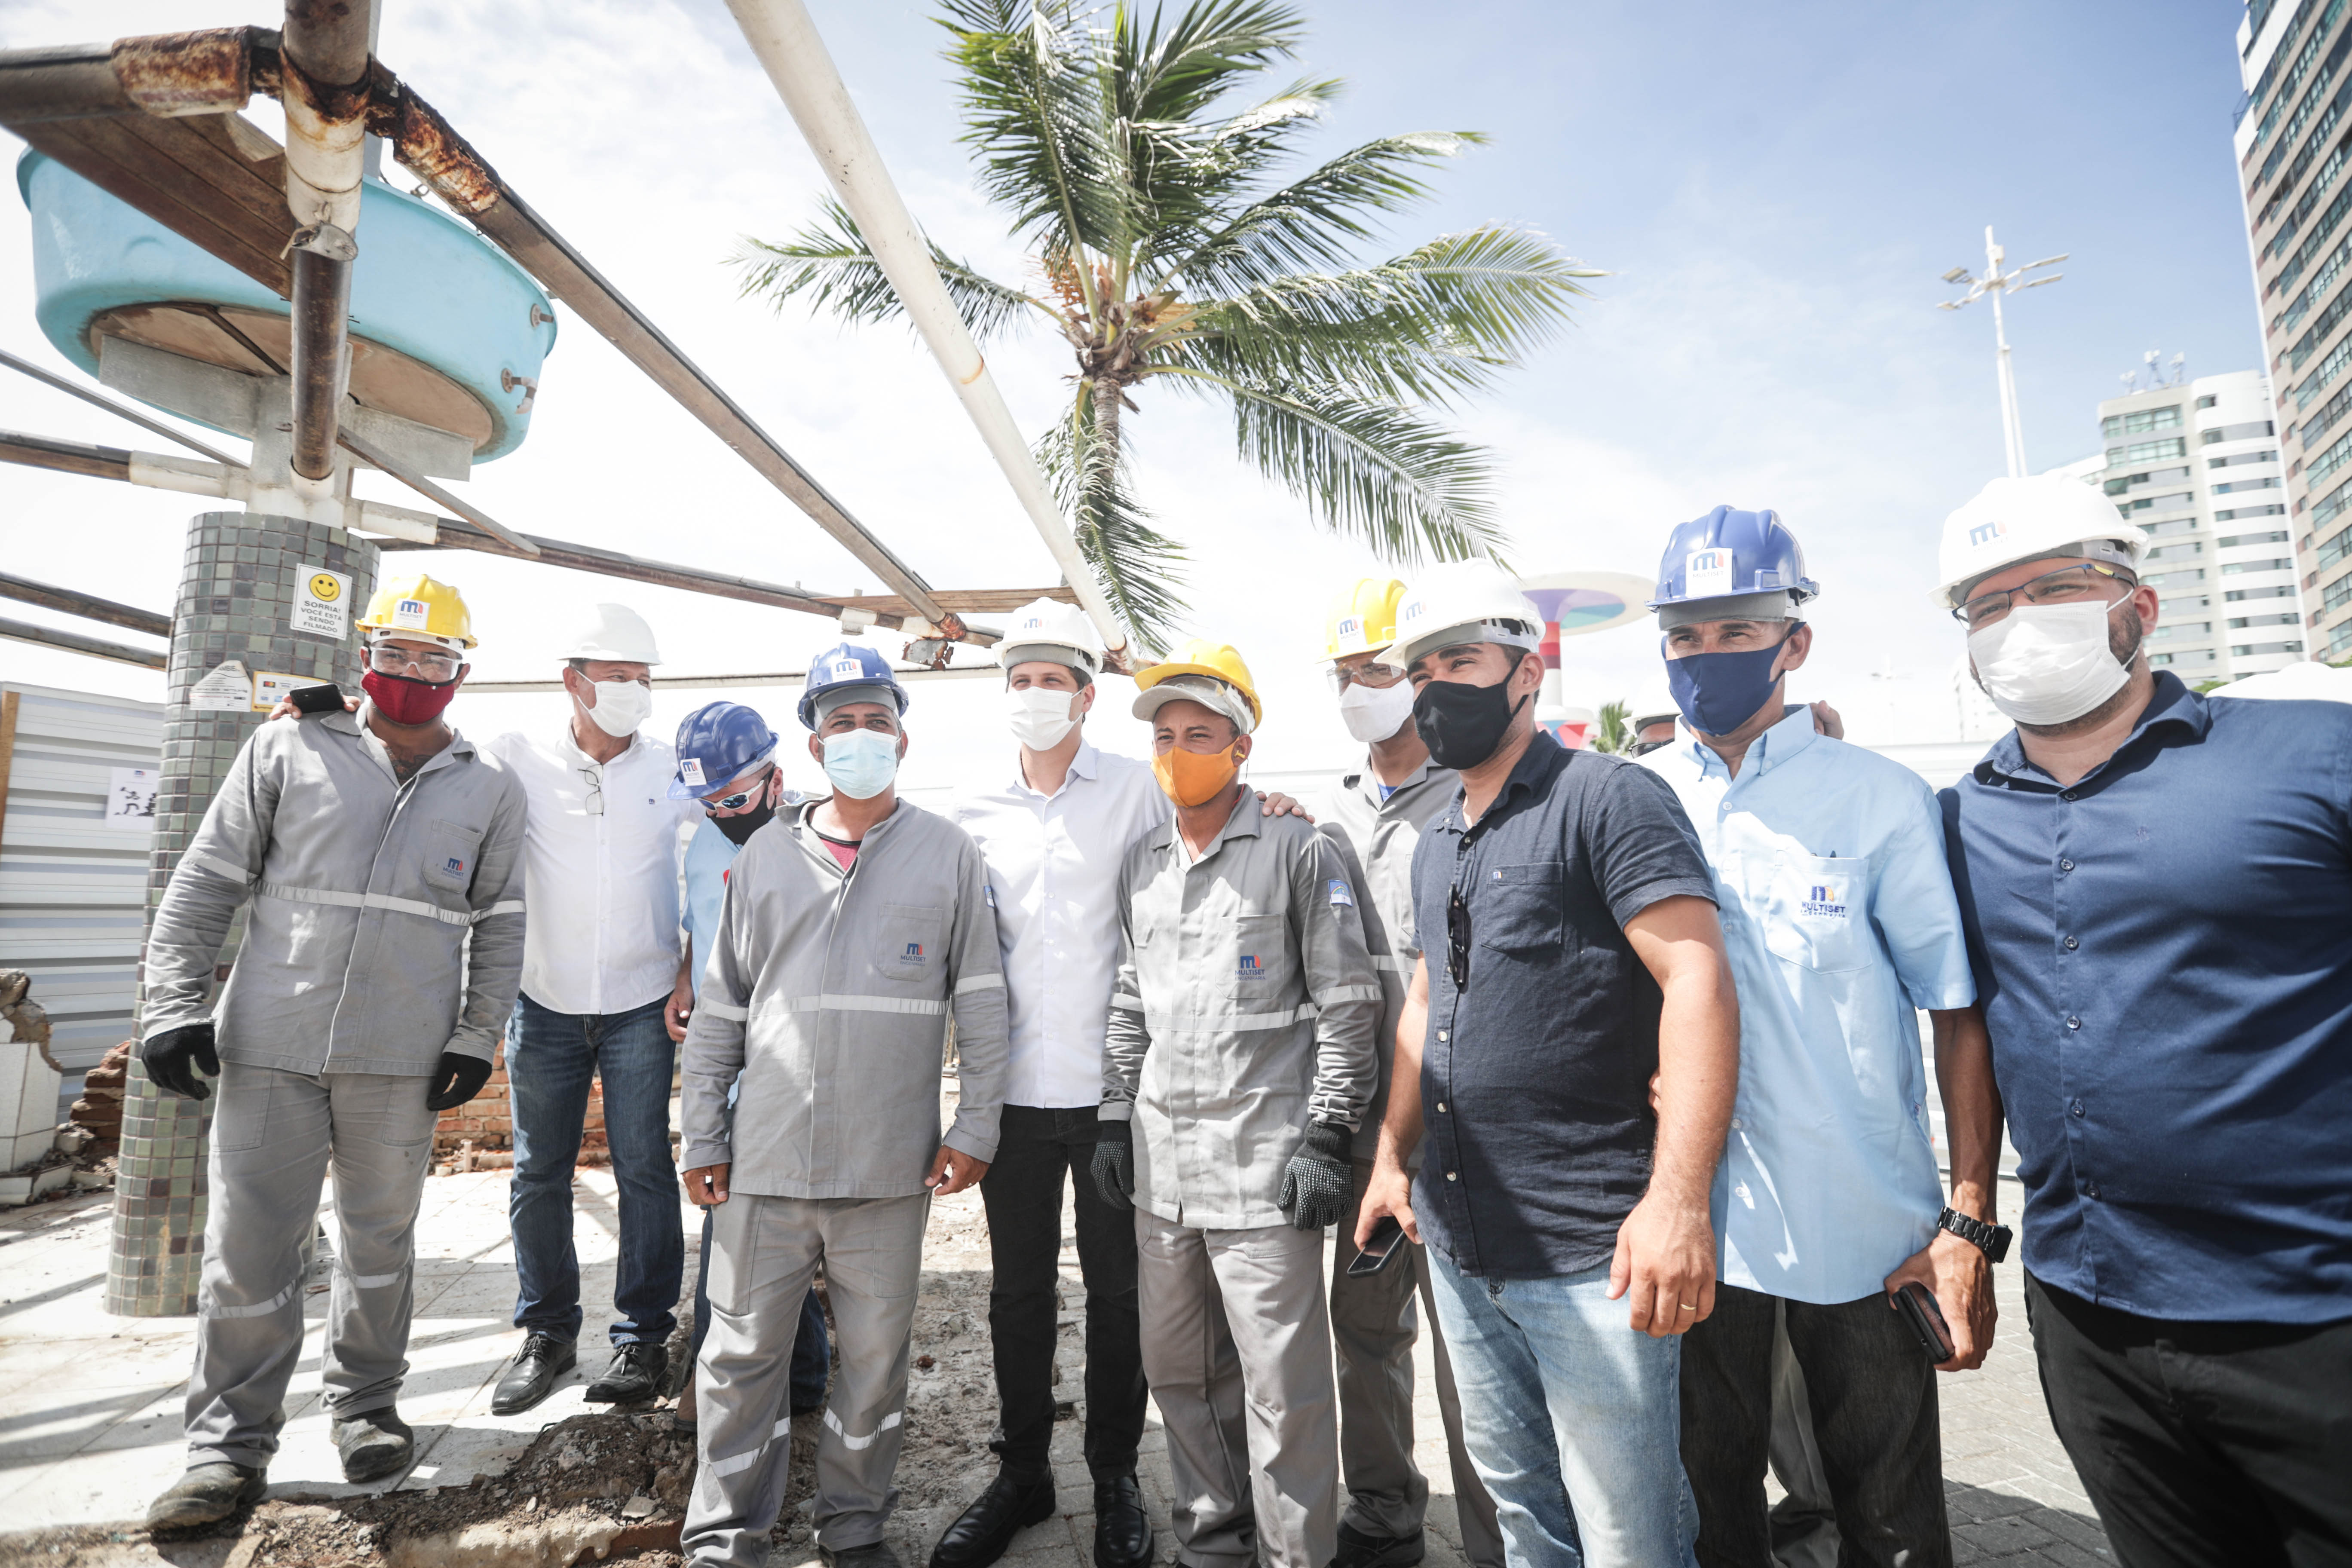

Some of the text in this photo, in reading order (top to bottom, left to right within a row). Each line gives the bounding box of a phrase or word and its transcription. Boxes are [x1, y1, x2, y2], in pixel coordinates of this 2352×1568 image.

[304, 600, 341, 613] SORRIA!
[308, 616, 335, 625] SENDO
[303, 621, 337, 633] FILMADO
[443, 866, 464, 877] MULTISET
[1801, 901, 1846, 913] MULTISET
